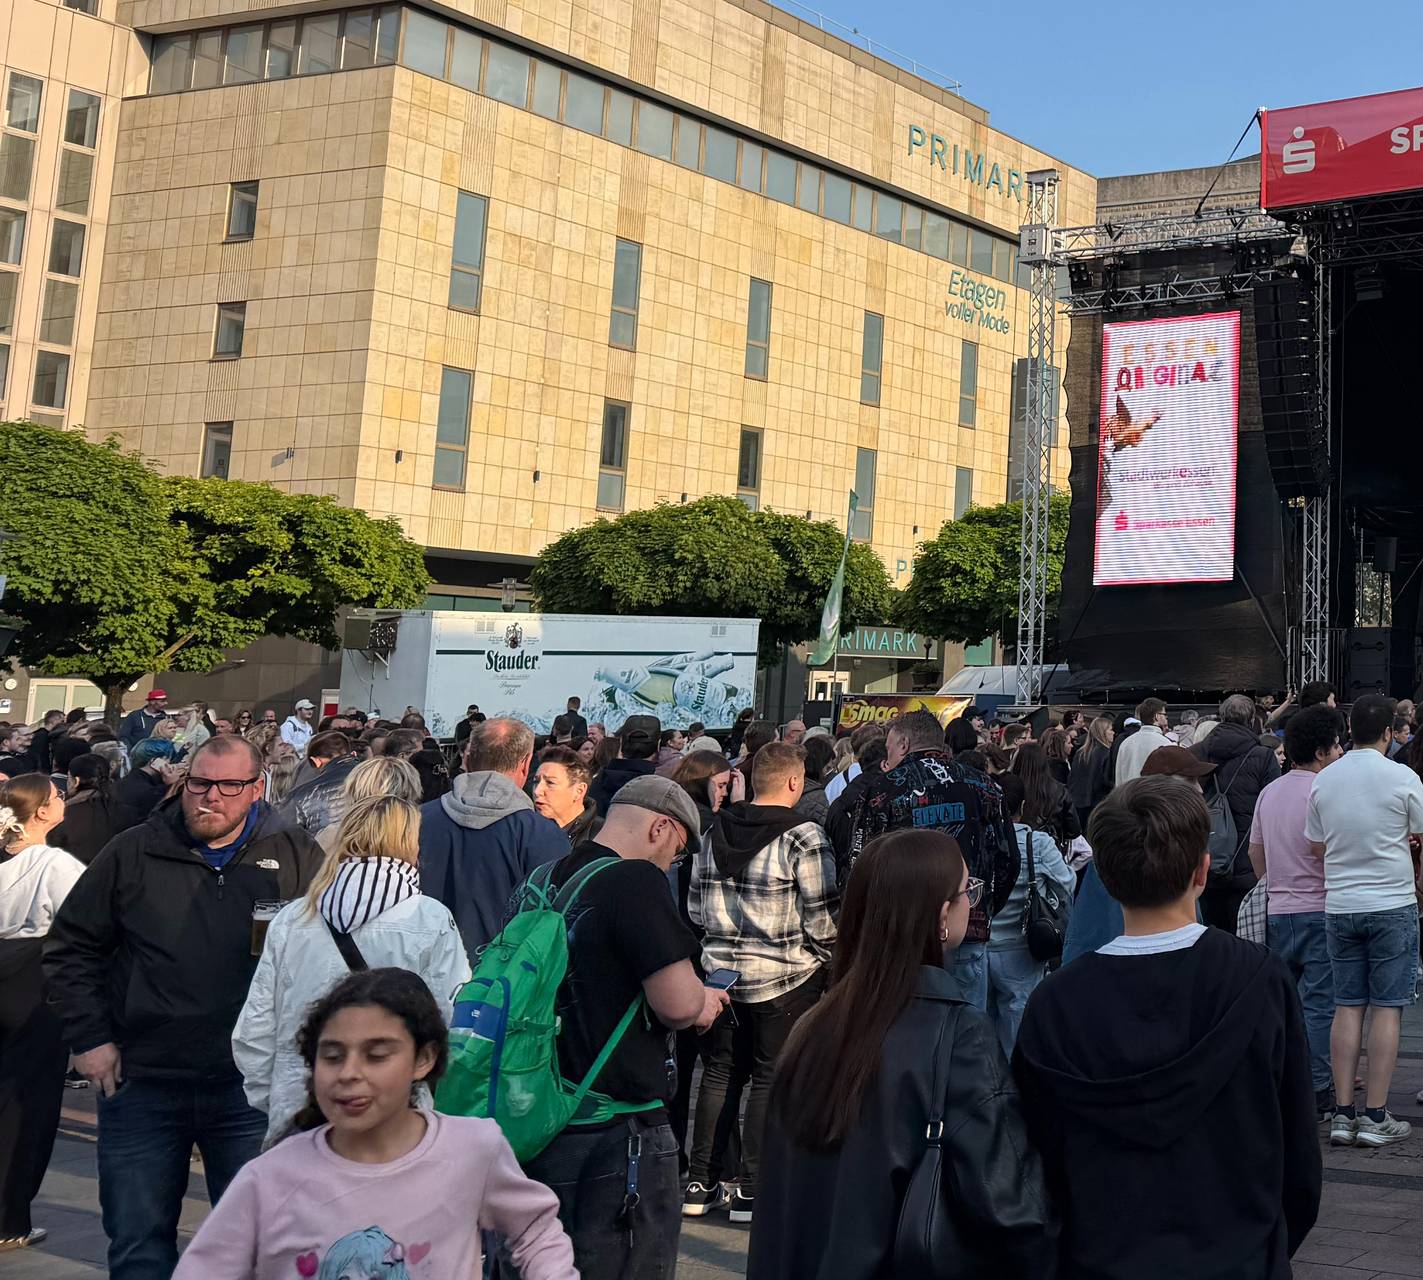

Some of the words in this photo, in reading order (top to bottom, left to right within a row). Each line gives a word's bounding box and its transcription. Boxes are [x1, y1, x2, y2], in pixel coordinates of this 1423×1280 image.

[907, 123, 1033, 208] PRIMAR
[949, 270, 1006, 311] Etagen
[945, 301, 977, 324] voller
[978, 310, 1010, 335] Mode
[485, 650, 539, 673] Stauder
